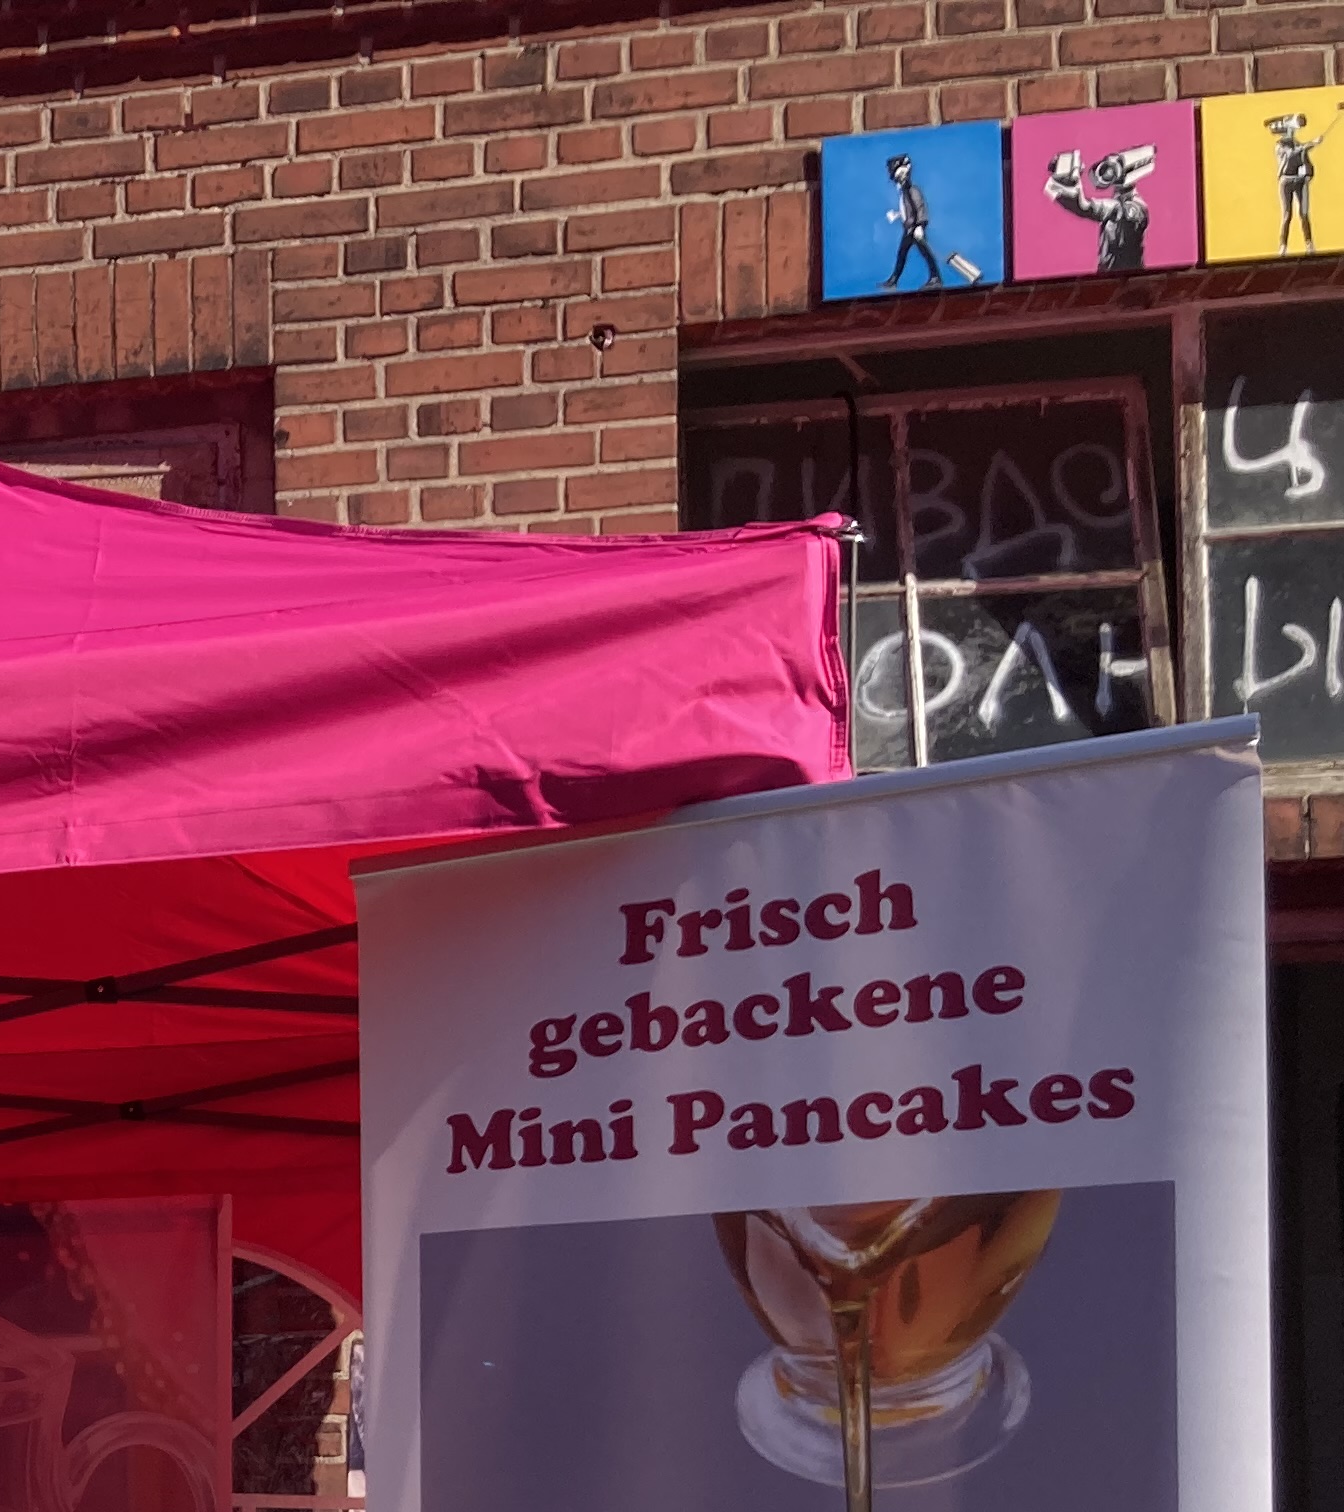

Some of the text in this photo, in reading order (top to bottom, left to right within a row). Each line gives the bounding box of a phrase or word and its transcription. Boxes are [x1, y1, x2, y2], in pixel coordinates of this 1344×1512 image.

[618, 868, 918, 967] Frisch
[527, 965, 1027, 1079] gebackene
[445, 1063, 1137, 1175] Mini Pancakes
